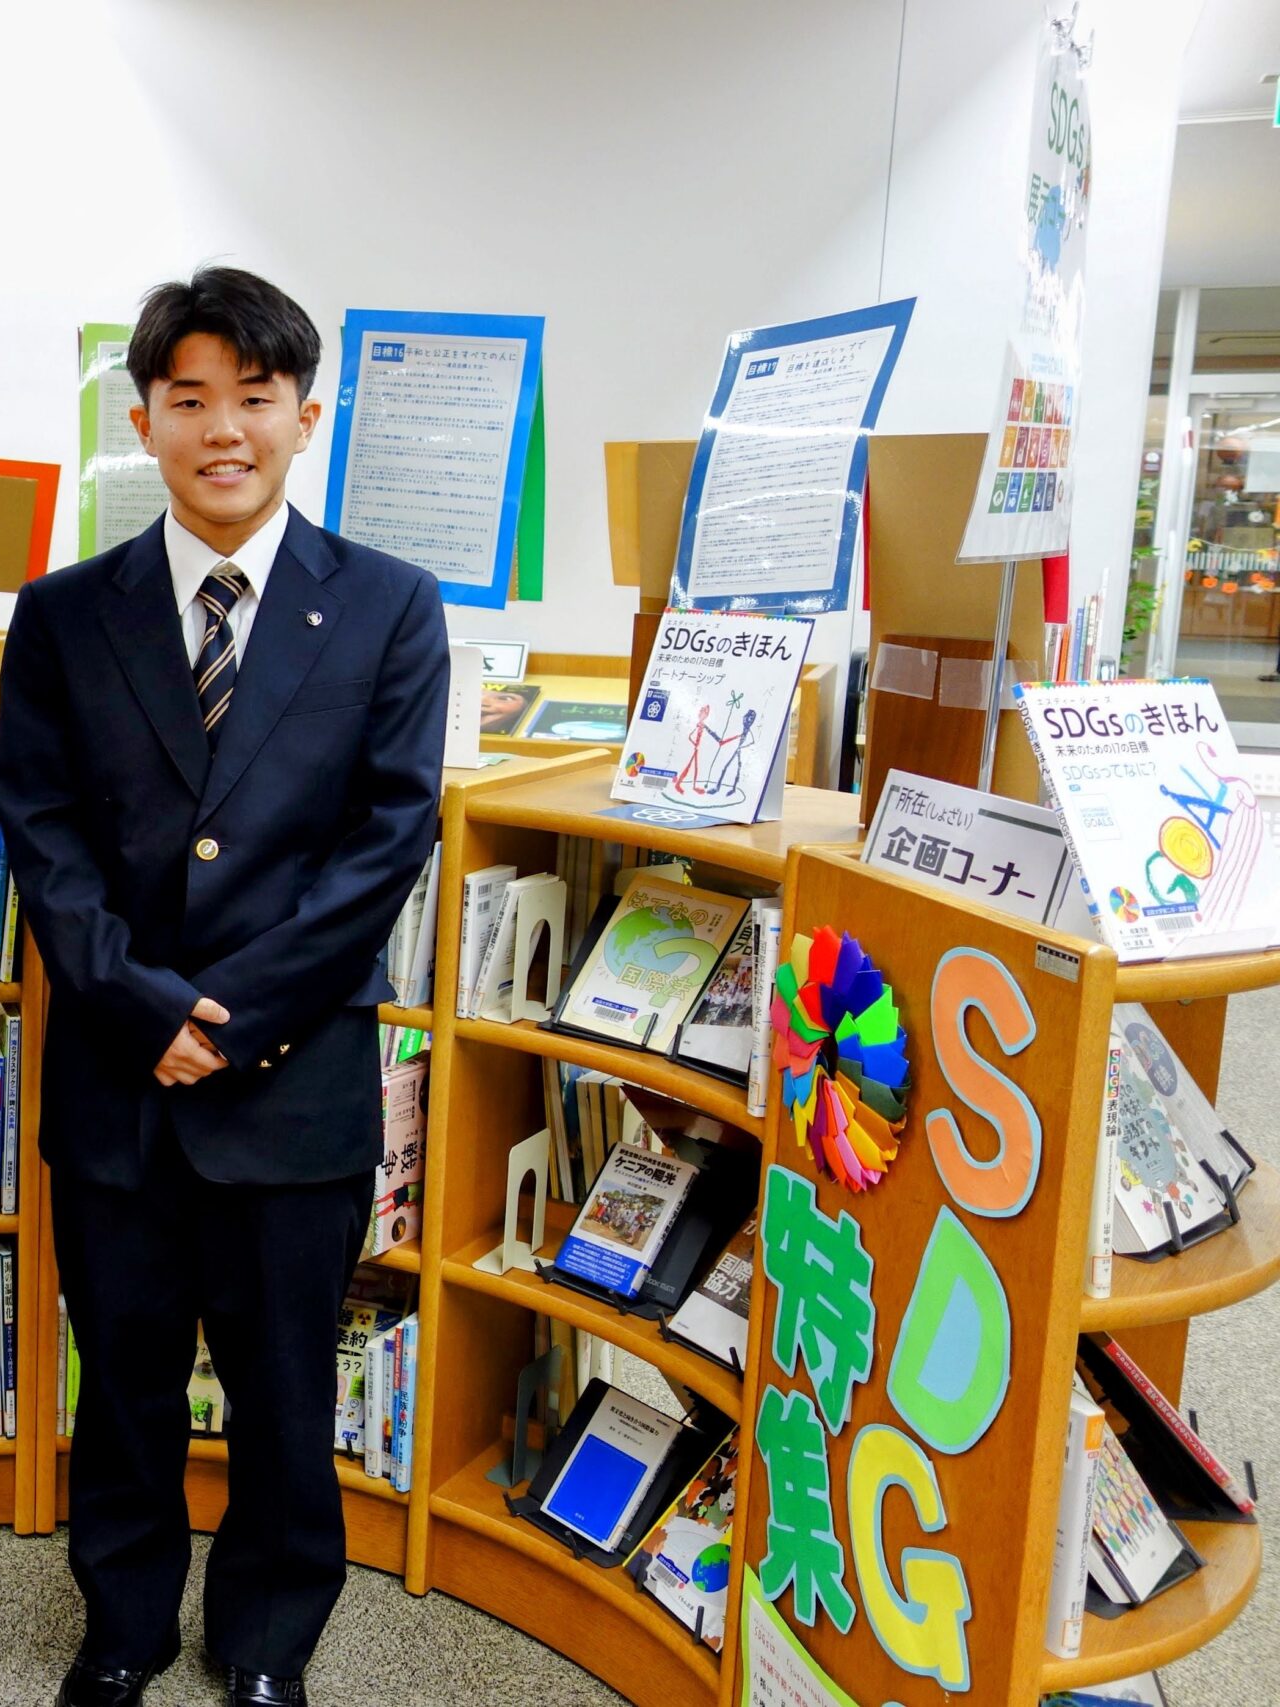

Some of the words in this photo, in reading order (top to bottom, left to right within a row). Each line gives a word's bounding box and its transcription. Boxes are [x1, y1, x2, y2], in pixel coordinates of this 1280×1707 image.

[1048, 81, 1084, 169] SDGs
[372, 345, 404, 358] 目標16
[656, 653, 725, 667] 未来のための17の目標
[661, 627, 793, 661] SDGsのきほん
[651, 667, 727, 686] パートナーシップ
[1043, 702, 1219, 740] SDGsのきほん
[1055, 741, 1151, 757] 未来のための17の目標
[895, 786, 974, 831] 所在(しょざい)
[880, 825, 1036, 900] 企画コーナー
[626, 890, 709, 925] はてなの
[616, 963, 693, 1001] 国際法
[614, 1155, 678, 1186] ケニアの陽光
[703, 1269, 742, 1301] 協力
[715, 1252, 754, 1284] 国際
[847, 945, 1043, 1707] SDG
[755, 1163, 876, 1636] 特集
